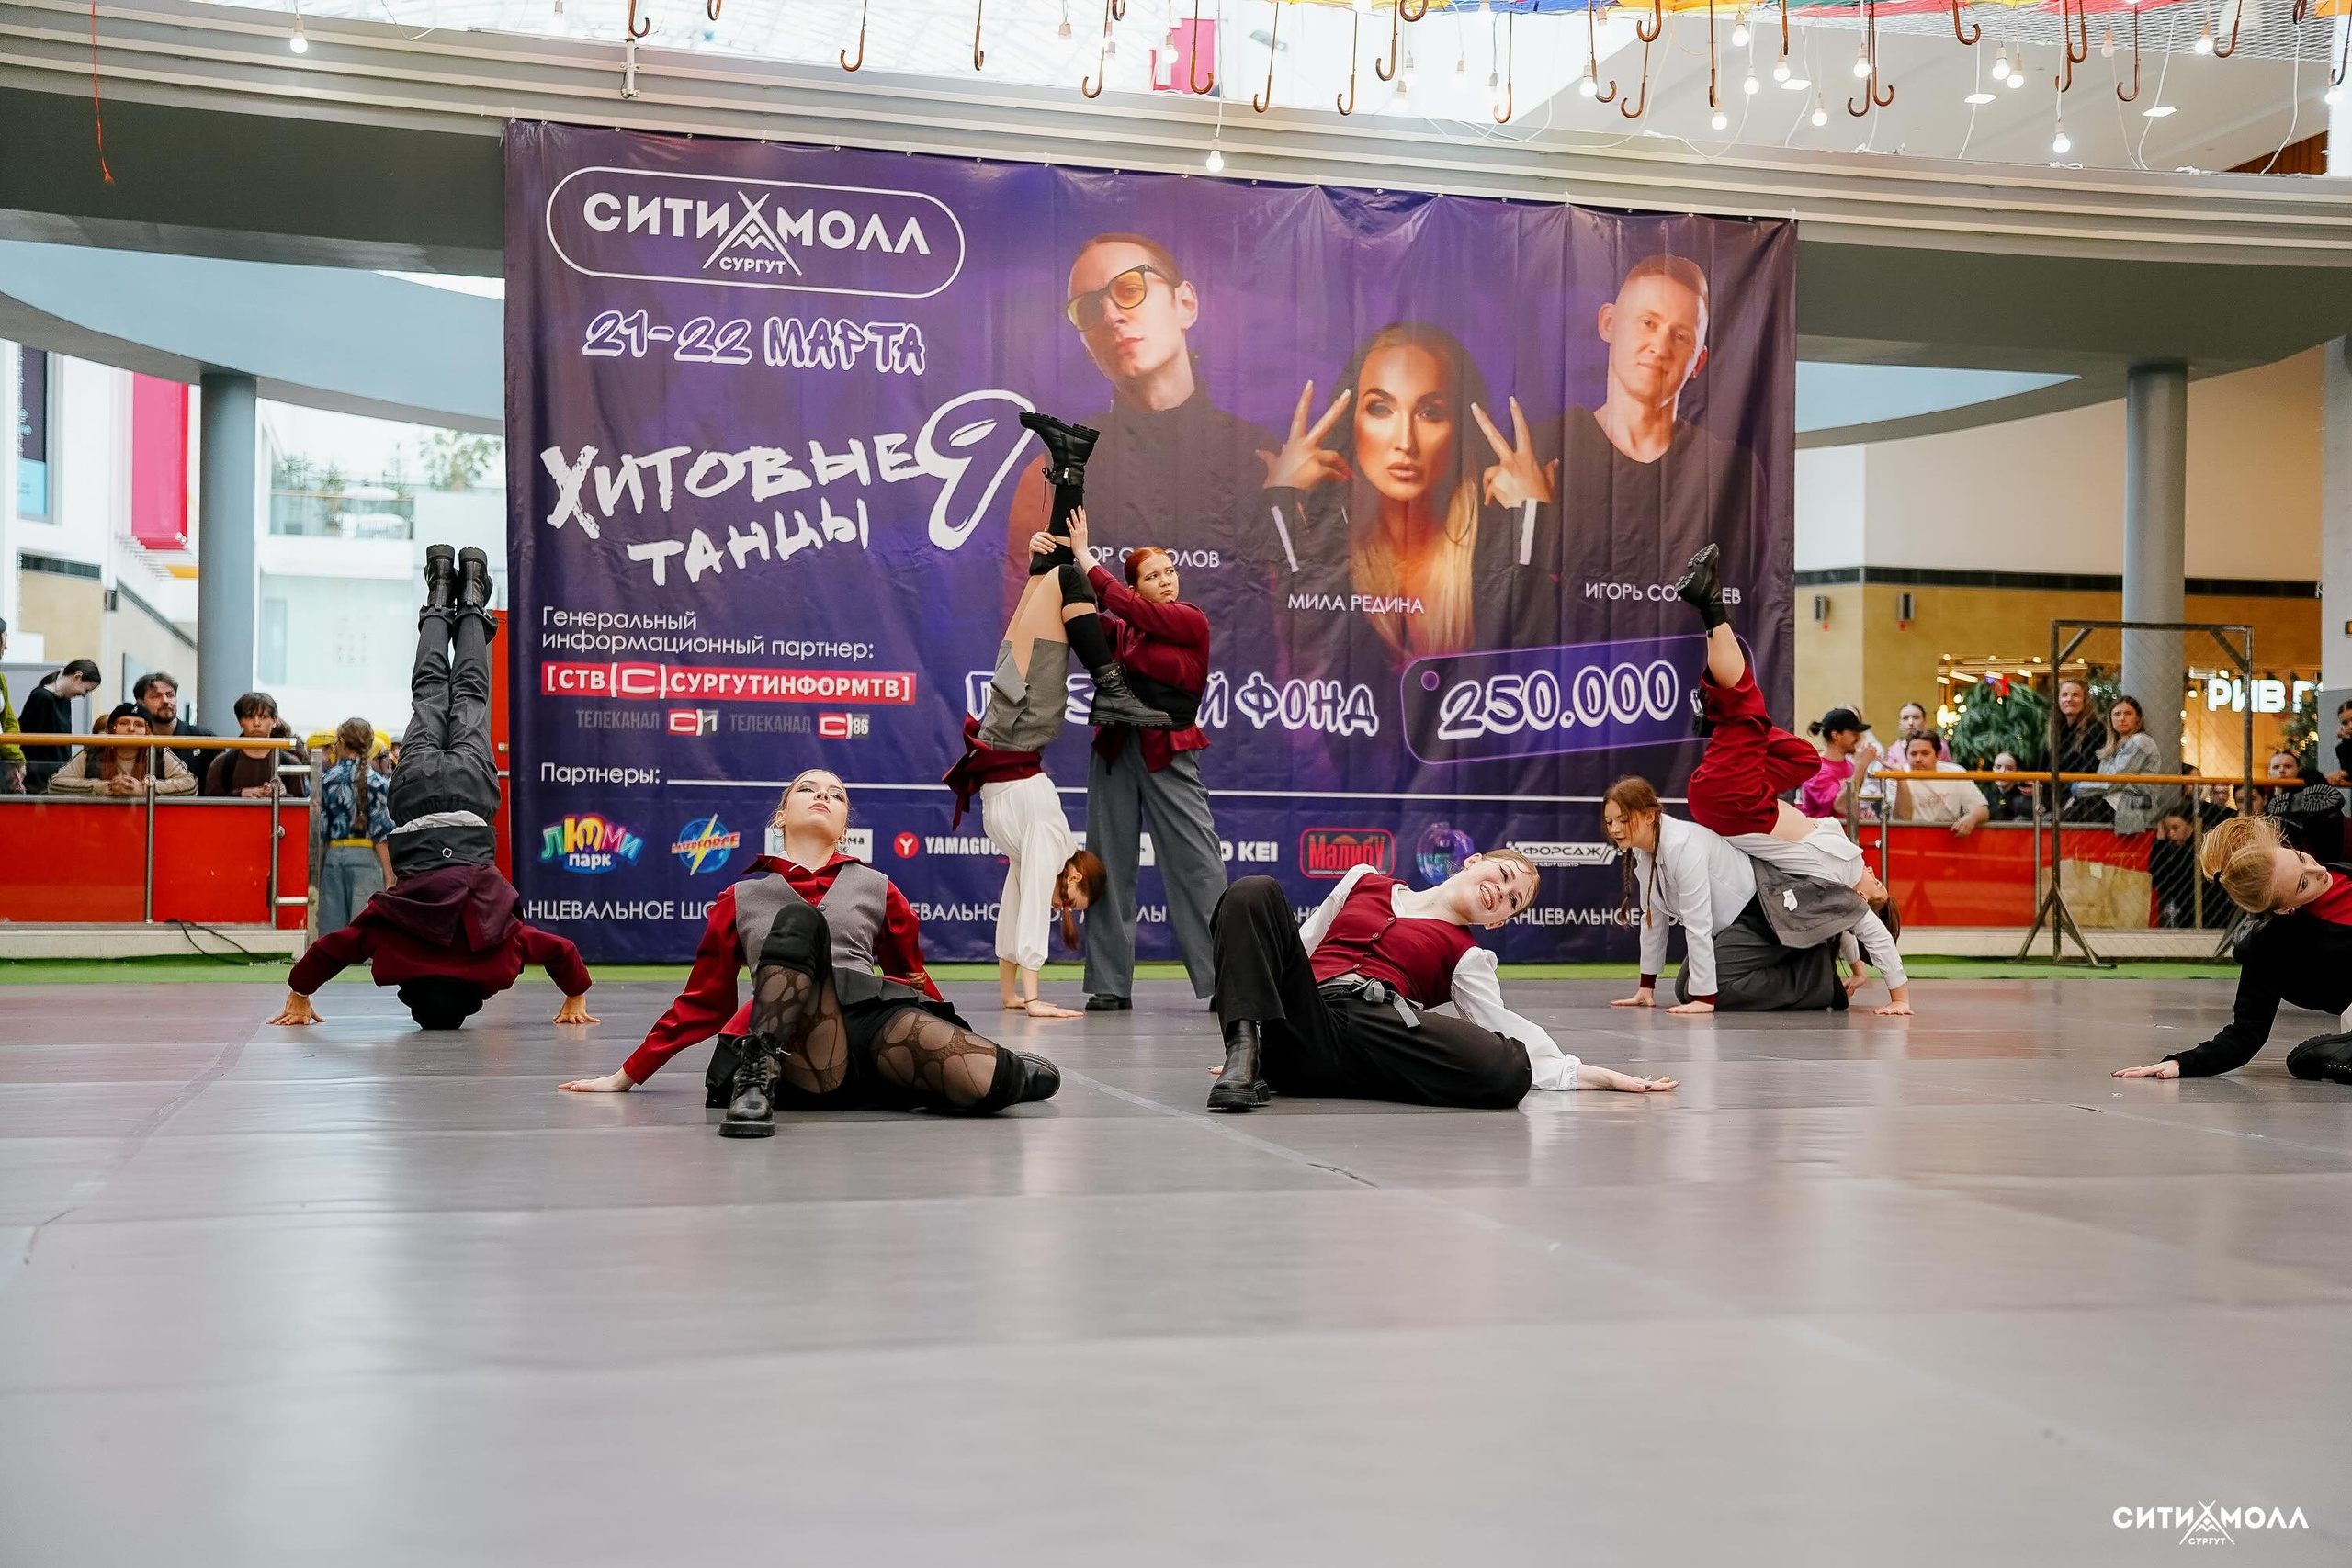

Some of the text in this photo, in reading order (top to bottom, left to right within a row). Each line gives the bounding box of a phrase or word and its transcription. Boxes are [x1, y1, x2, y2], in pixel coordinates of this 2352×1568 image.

[583, 192, 931, 255] СИТИ МОЛЛ
[719, 256, 786, 275] СУРГУТ
[582, 310, 927, 376] 21-22 МАРТА
[1585, 582, 1644, 601] ИГОРЬ
[1288, 593, 1425, 615] МИЛА РЕДИНА
[542, 606, 697, 632] Генеральный
[542, 629, 875, 662] информационный партнер:
[1437, 659, 1679, 741] 250.000
[2207, 678, 2287, 713] РИВ
[576, 709, 660, 730] ТЕЛЕКАНАЛ
[729, 714, 811, 733] ТЕЛЕКАНАЛ
[541, 761, 661, 786] Партнеры:
[569, 853, 612, 871] парк
[1238, 840, 1279, 862] KEI
[1523, 846, 1601, 857] ФОРСАЖ
[523, 899, 674, 921] НЦЕВАЛЬНОЕ
